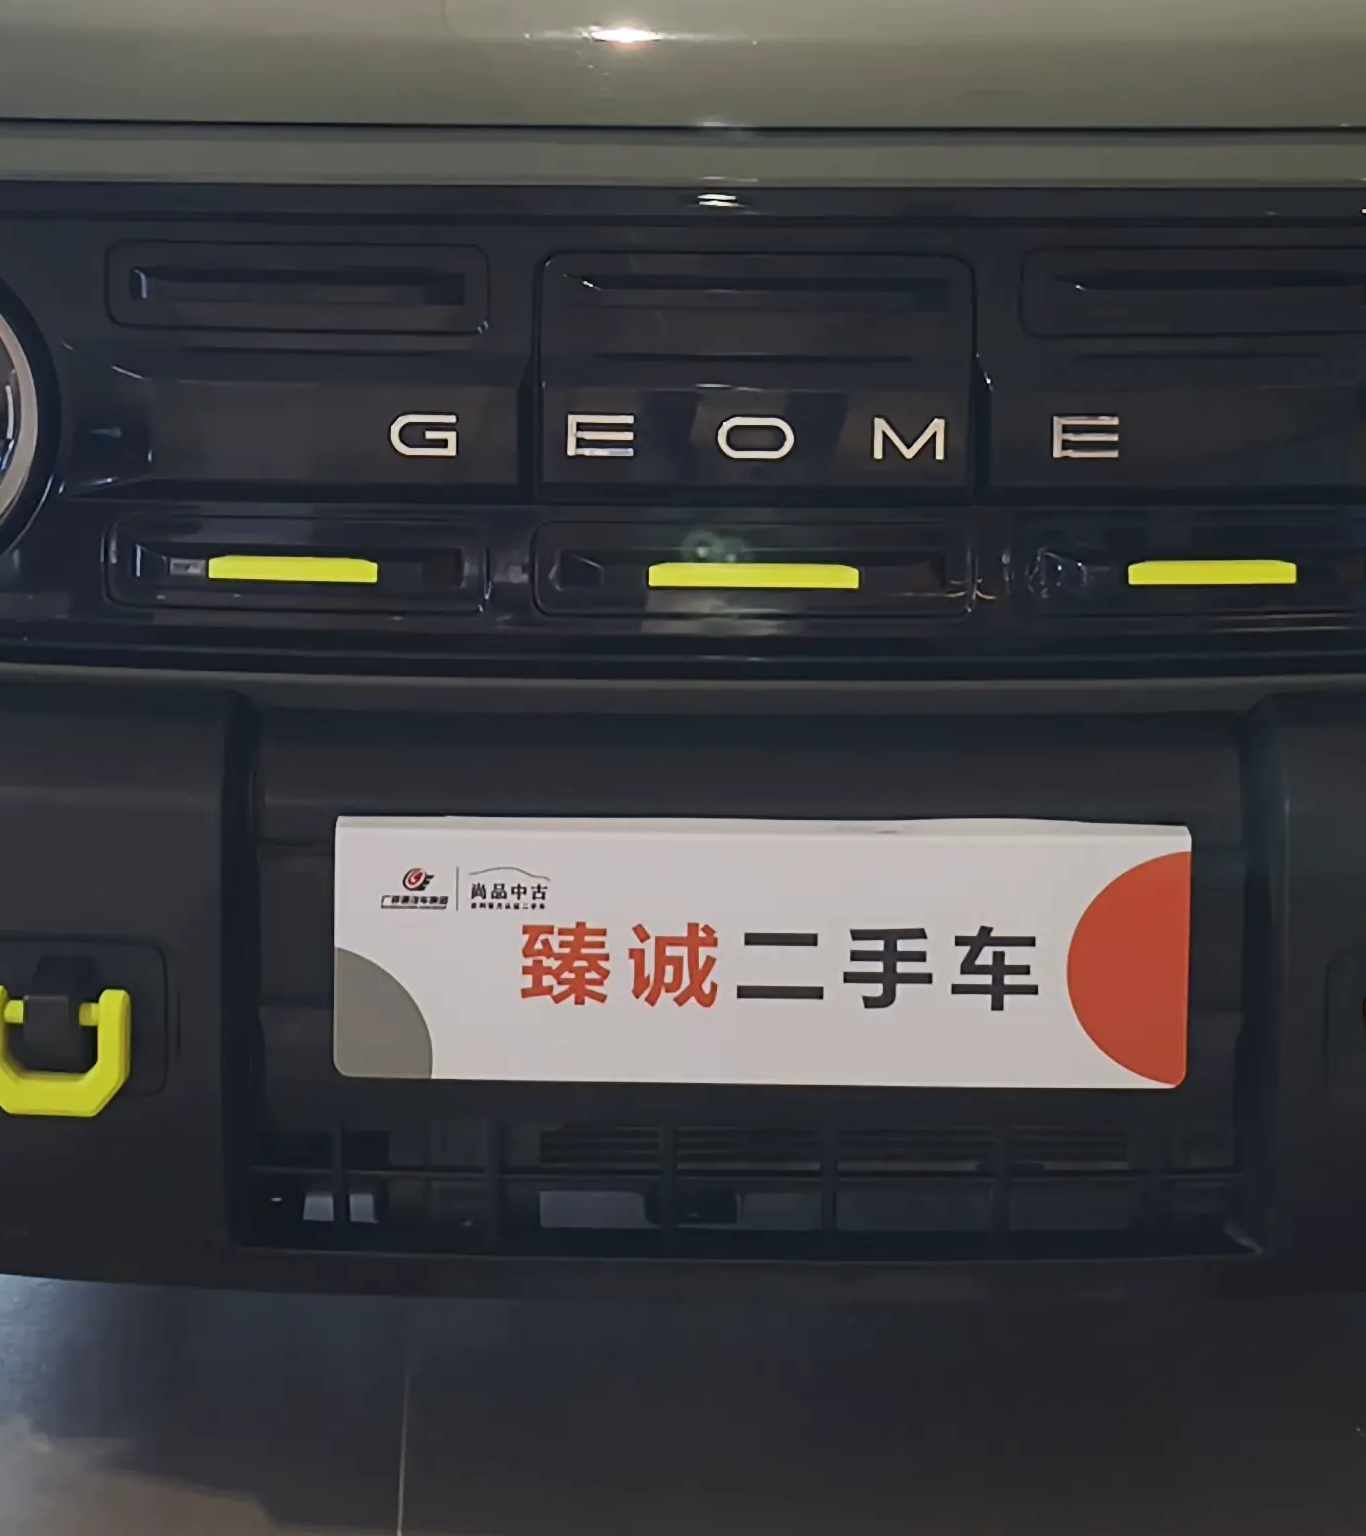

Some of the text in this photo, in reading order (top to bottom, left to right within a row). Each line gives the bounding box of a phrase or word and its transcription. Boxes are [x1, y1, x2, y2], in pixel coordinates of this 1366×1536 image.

[390, 414, 1119, 461] GEOME
[471, 882, 548, 900] 尚品中古
[519, 921, 1040, 1013] 臻诚二手车
